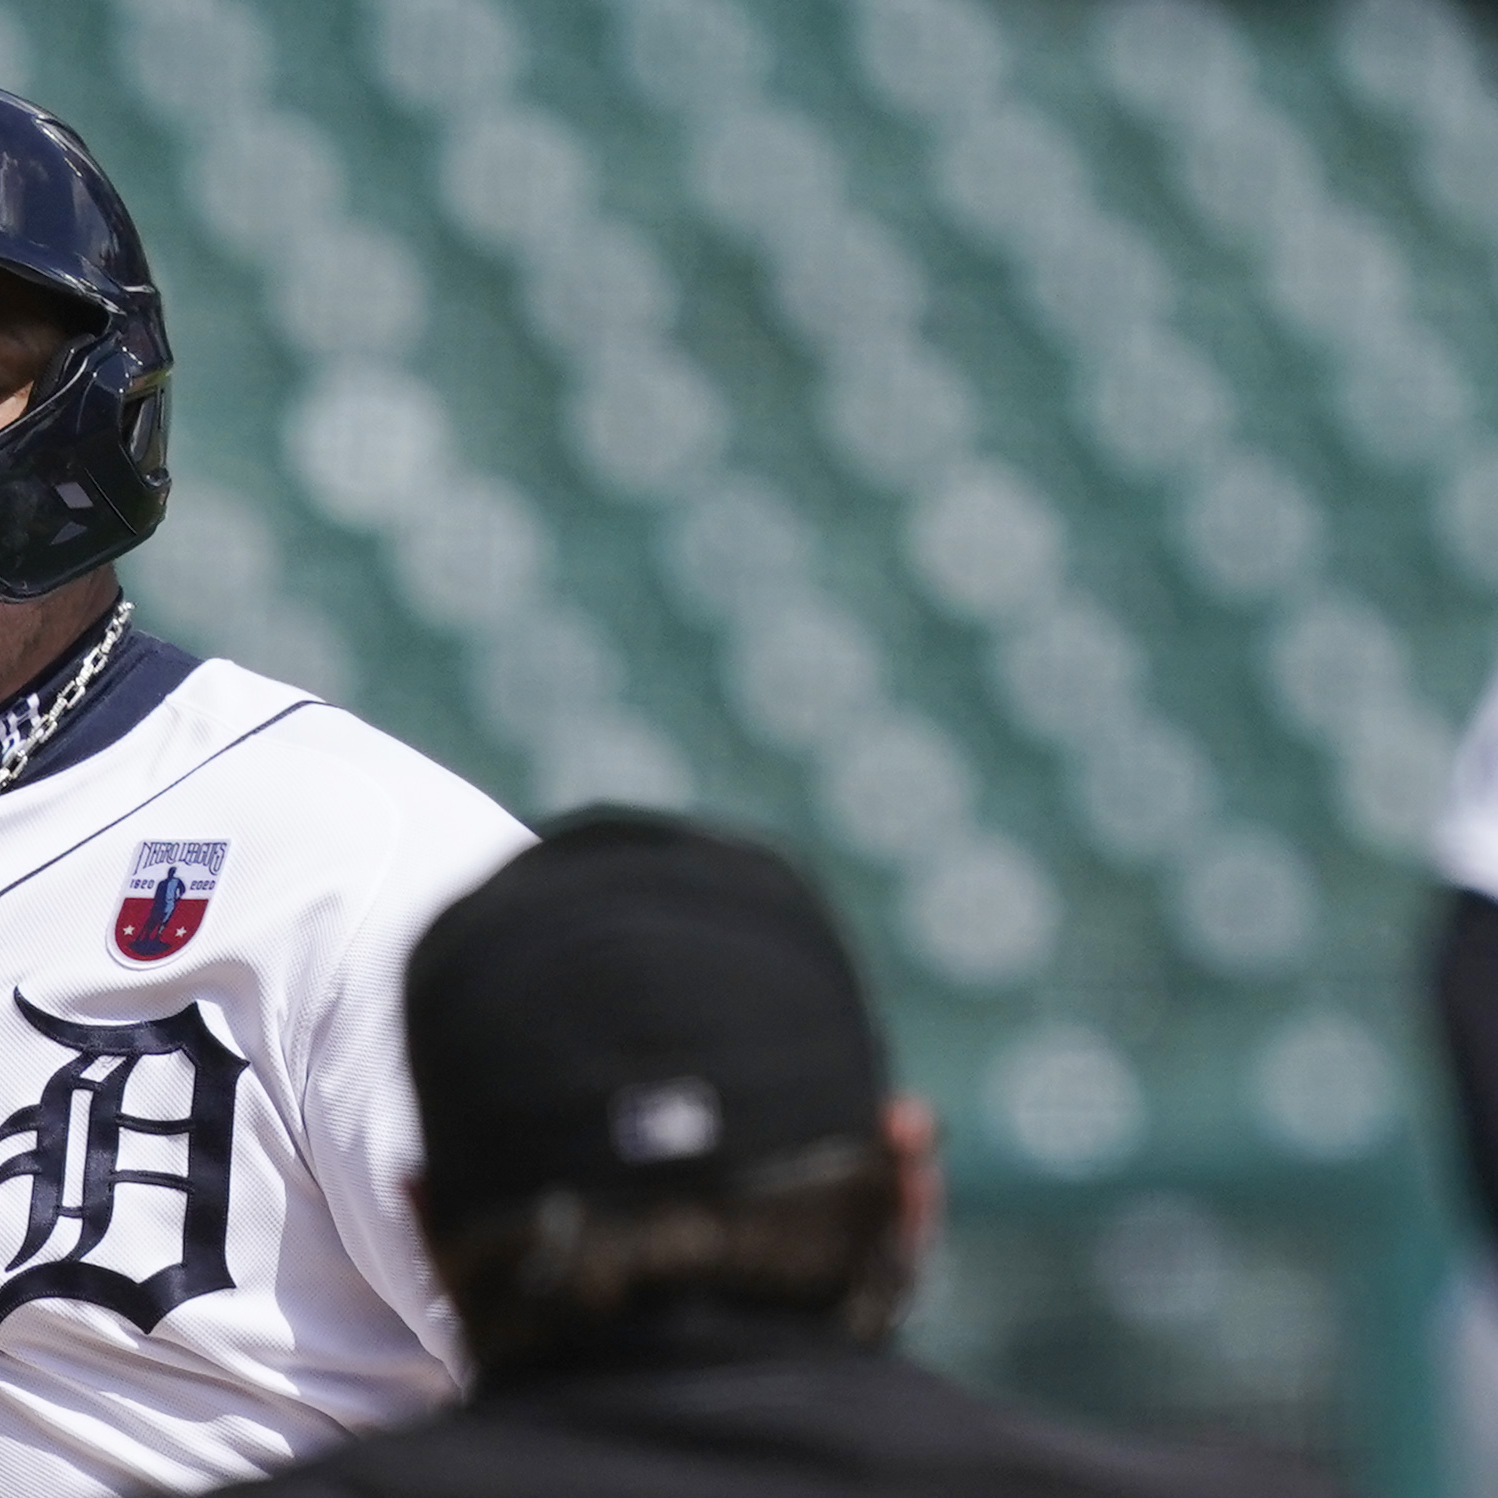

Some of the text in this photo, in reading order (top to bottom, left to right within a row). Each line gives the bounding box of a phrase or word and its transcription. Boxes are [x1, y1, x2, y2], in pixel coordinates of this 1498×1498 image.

[133, 841, 228, 876] NEGRO LEAGUES
[129, 878, 156, 890] 1920
[189, 879, 217, 891] 2020
